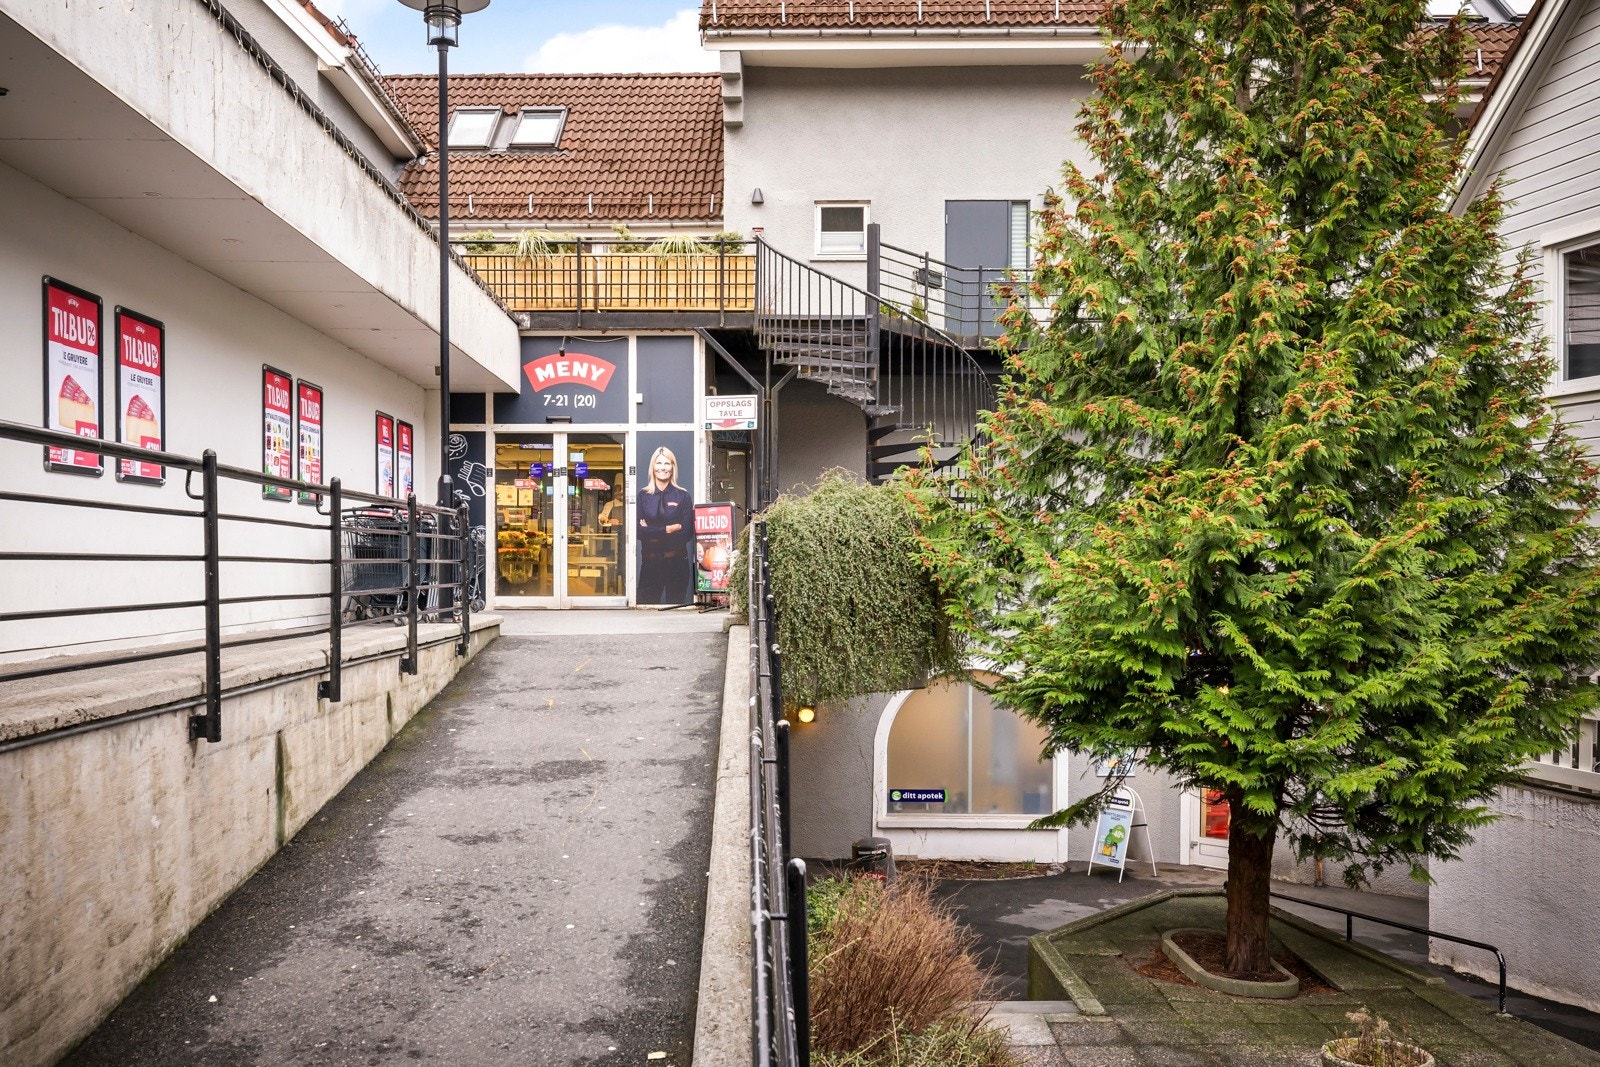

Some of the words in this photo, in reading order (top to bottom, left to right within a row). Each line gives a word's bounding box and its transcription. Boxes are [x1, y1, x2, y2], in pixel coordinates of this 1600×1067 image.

[51, 306, 96, 347] TILBUD
[122, 333, 159, 369] TILBUD
[534, 360, 606, 383] MENY
[266, 383, 289, 410] TILBUD
[543, 394, 569, 407] 7-21
[573, 393, 596, 409] (20)
[710, 400, 752, 408] OPPSLAGS
[300, 397, 320, 421] TILBUD
[696, 514, 729, 530] TILBUD
[917, 792, 943, 800] apotek
